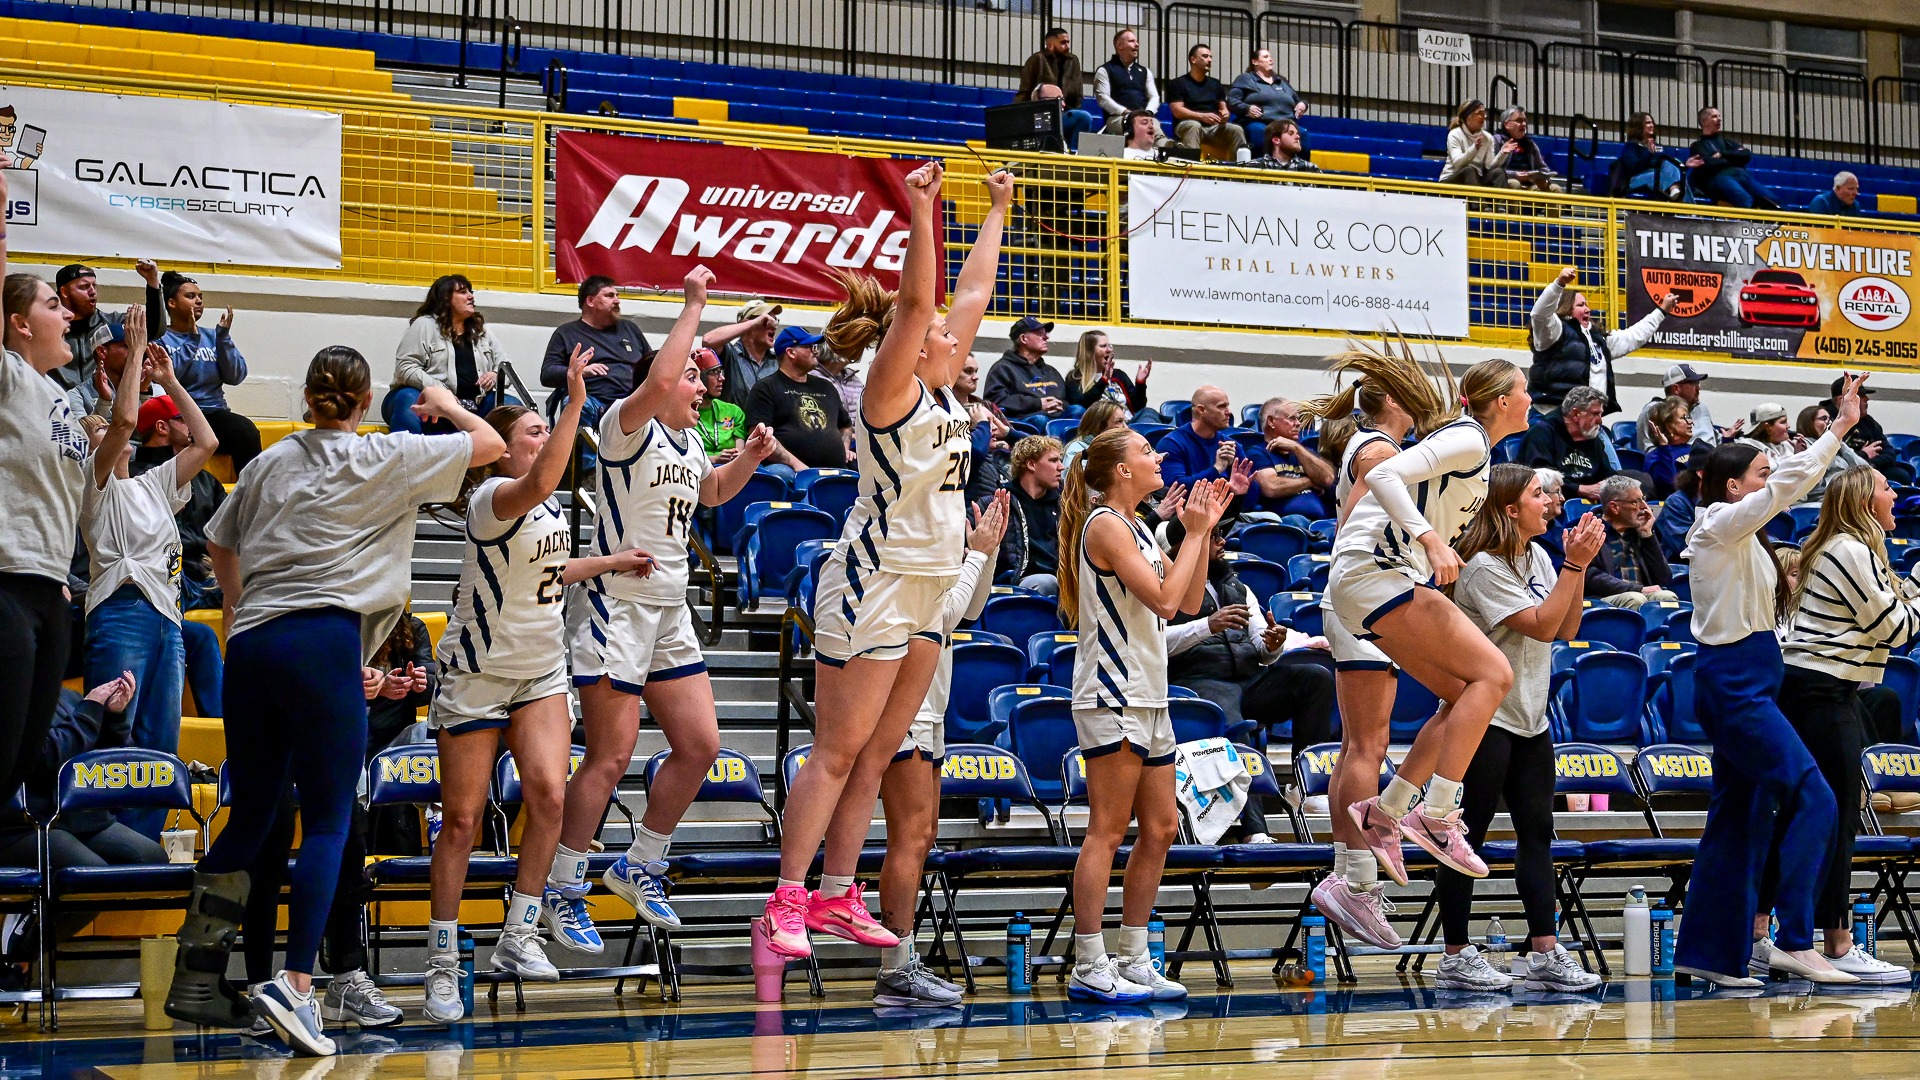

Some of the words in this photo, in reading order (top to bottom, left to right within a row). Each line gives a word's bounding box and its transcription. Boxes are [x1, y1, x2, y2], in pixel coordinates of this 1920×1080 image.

[1424, 35, 1464, 48] ADULT
[1419, 47, 1471, 62] SECTION
[75, 158, 326, 198] GALACTICA
[109, 194, 294, 218] CYBERSECURITY
[699, 184, 865, 216] universal
[575, 174, 911, 271] Awards
[1153, 208, 1299, 248] HEENAN
[1313, 220, 1336, 250] &
[1347, 222, 1445, 258] COOK
[1742, 227, 1809, 240] DISCOVER
[1635, 230, 1685, 260] THE
[1692, 235, 1758, 265] NEXT
[1766, 241, 1913, 277] ADVENTURE
[1205, 256, 1275, 274] TRIAL
[1290, 262, 1396, 281] LAWYERS
[1646, 271, 1671, 285] AUTO
[1674, 273, 1719, 288] BROKERS
[1170, 287, 1325, 307] www.lawmontana.com
[1332, 294, 1431, 313] 406-888-4444
[1671, 297, 1712, 315] ONTANA
[1844, 302, 1903, 316] RENTAL
[1814, 336, 1850, 356] (406)
[1855, 338, 1918, 359] 245-9055
[665, 496, 692, 539] 14
[73, 761, 175, 788] MSUB
[940, 754, 1017, 780] MSUB
[1555, 753, 1619, 778] MSUB
[1646, 754, 1713, 778] MSUB
